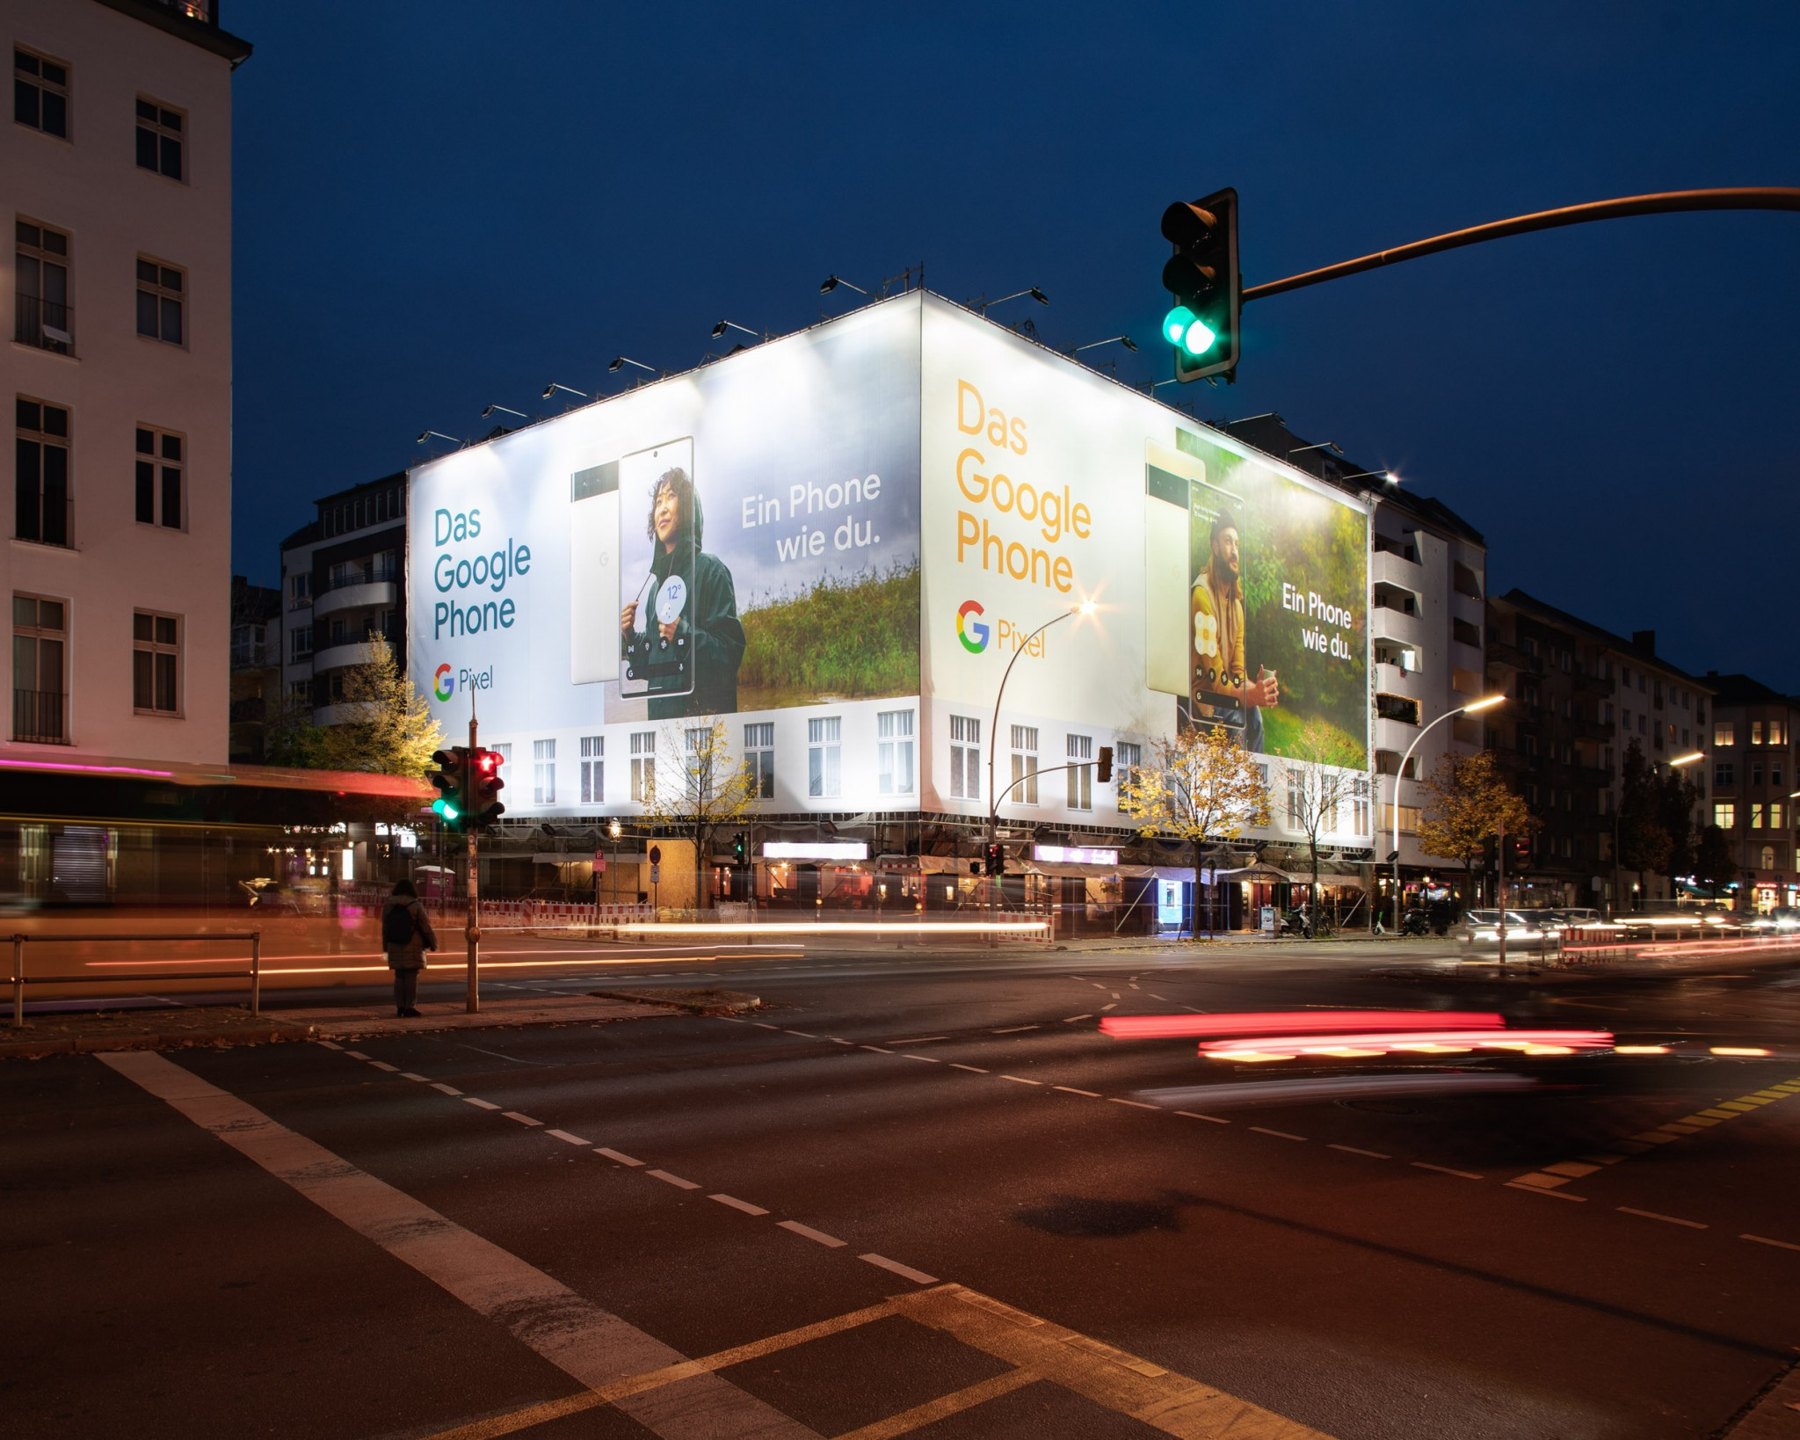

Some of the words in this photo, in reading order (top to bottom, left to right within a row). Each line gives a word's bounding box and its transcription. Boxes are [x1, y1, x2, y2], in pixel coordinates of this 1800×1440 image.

[957, 379, 1028, 456] Das
[741, 493, 781, 529] Ein
[790, 473, 881, 518] Phone
[956, 448, 1092, 544] Google
[435, 508, 481, 547] Das
[776, 525, 826, 562] wie
[834, 516, 881, 551] du.
[957, 510, 1073, 593] Phone
[434, 537, 531, 593] Google
[435, 598, 516, 640] Phone
[956, 600, 990, 653] G
[998, 619, 1045, 659] Pixel
[1282, 582, 1305, 614] Ein
[1309, 591, 1352, 629] Phone
[1302, 625, 1327, 653] wie
[1330, 633, 1352, 660] du.
[434, 663, 455, 702] G
[459, 664, 493, 692] Pixel
